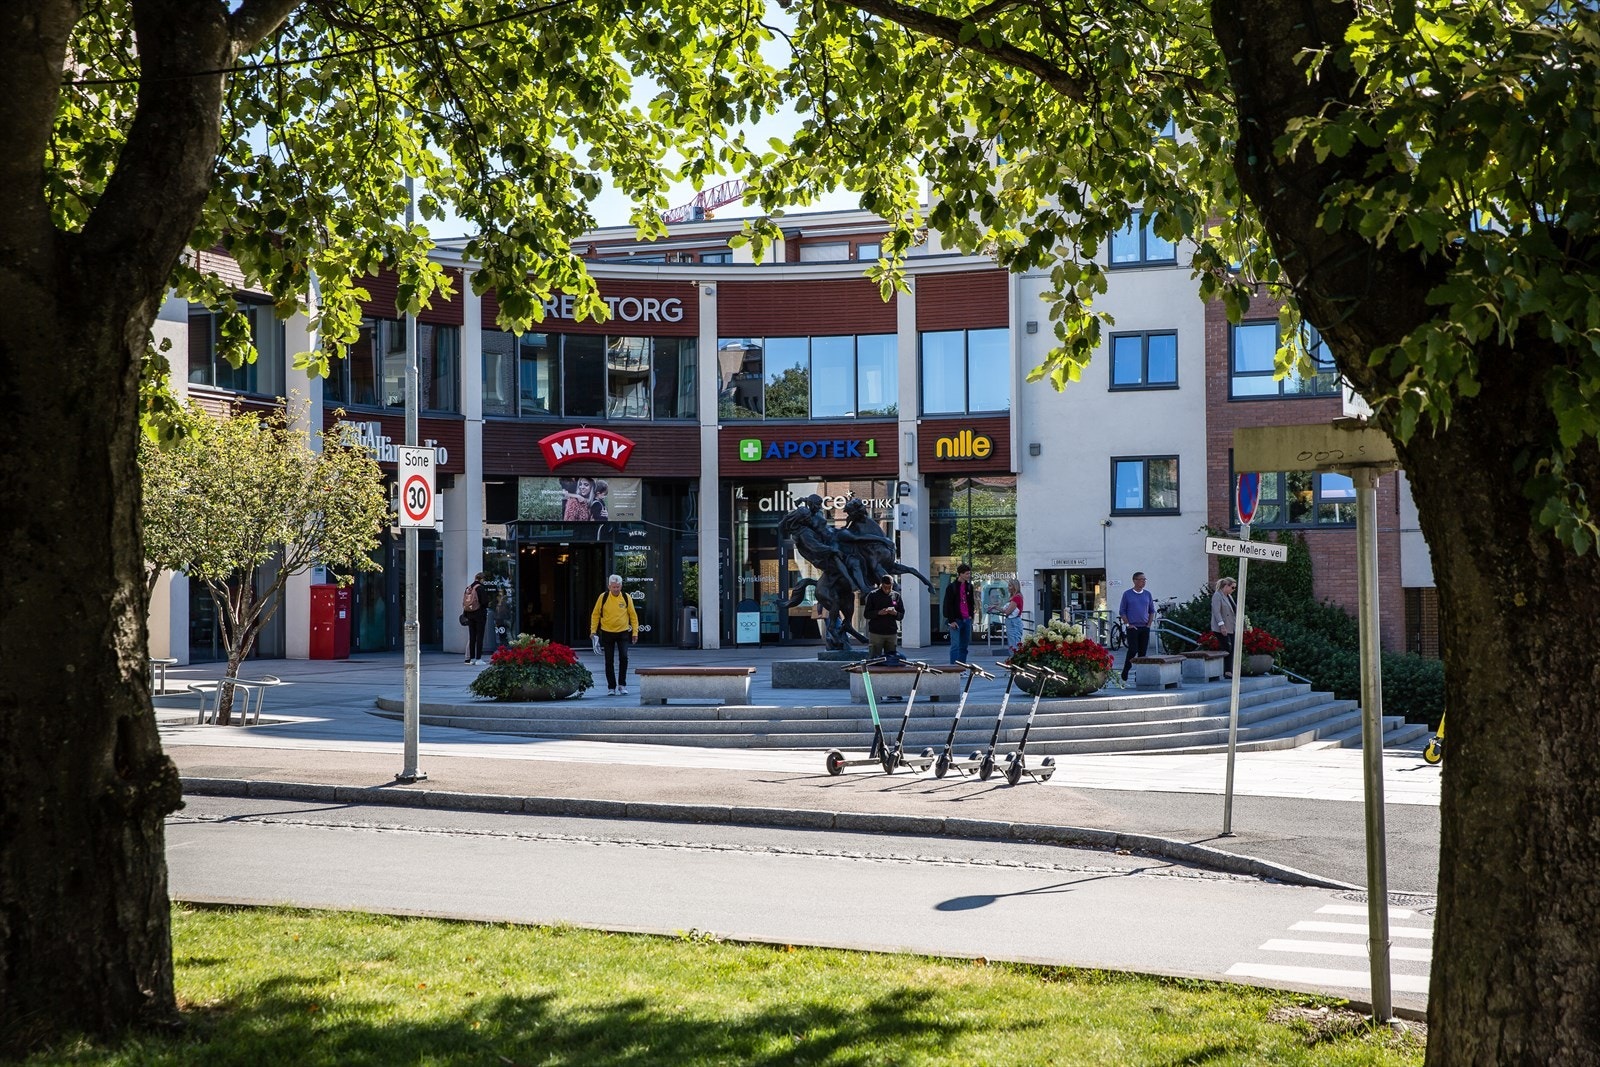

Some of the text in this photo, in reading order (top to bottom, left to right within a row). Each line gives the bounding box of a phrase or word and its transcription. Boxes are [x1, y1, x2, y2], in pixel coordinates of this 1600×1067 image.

[603, 296, 683, 322] TORG
[551, 436, 627, 460] MENY
[765, 438, 878, 458] APOTEK 1
[935, 429, 991, 458] nille
[405, 452, 429, 467] Sone
[408, 486, 426, 509] 30
[861, 498, 893, 508] PTIKK
[1211, 541, 1282, 558] Peter Møllers vei
